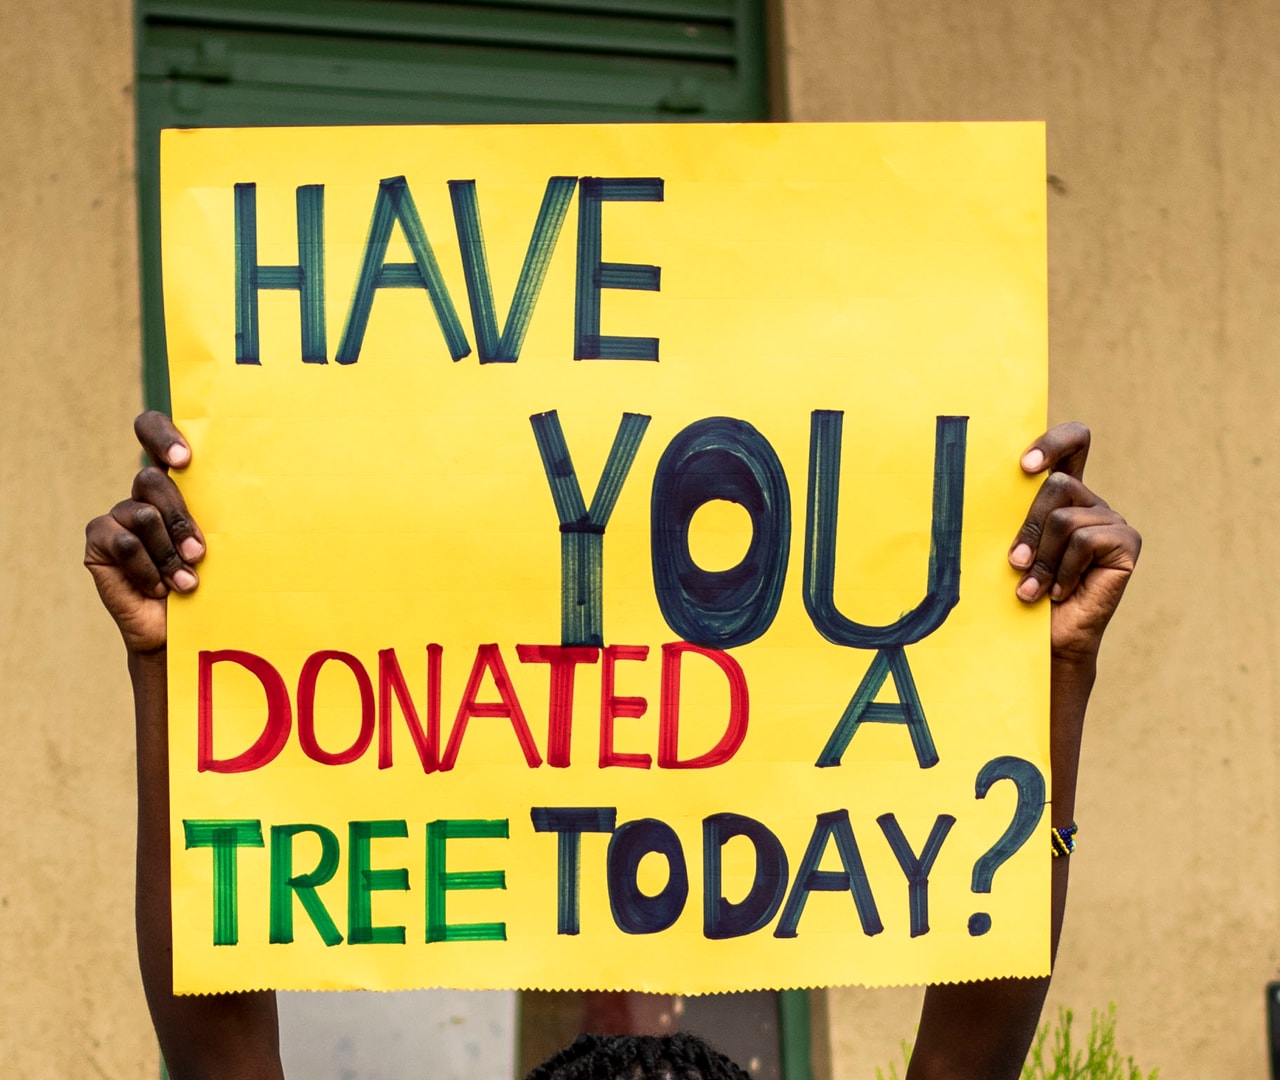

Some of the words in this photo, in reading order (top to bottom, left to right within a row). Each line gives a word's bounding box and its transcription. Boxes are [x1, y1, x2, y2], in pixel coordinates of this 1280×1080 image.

[233, 175, 665, 366] HAVE
[529, 409, 970, 648] YOU
[197, 641, 749, 774] DONATED
[815, 645, 940, 769] A
[183, 818, 510, 947] TREE
[531, 755, 1047, 940] TODAY?
